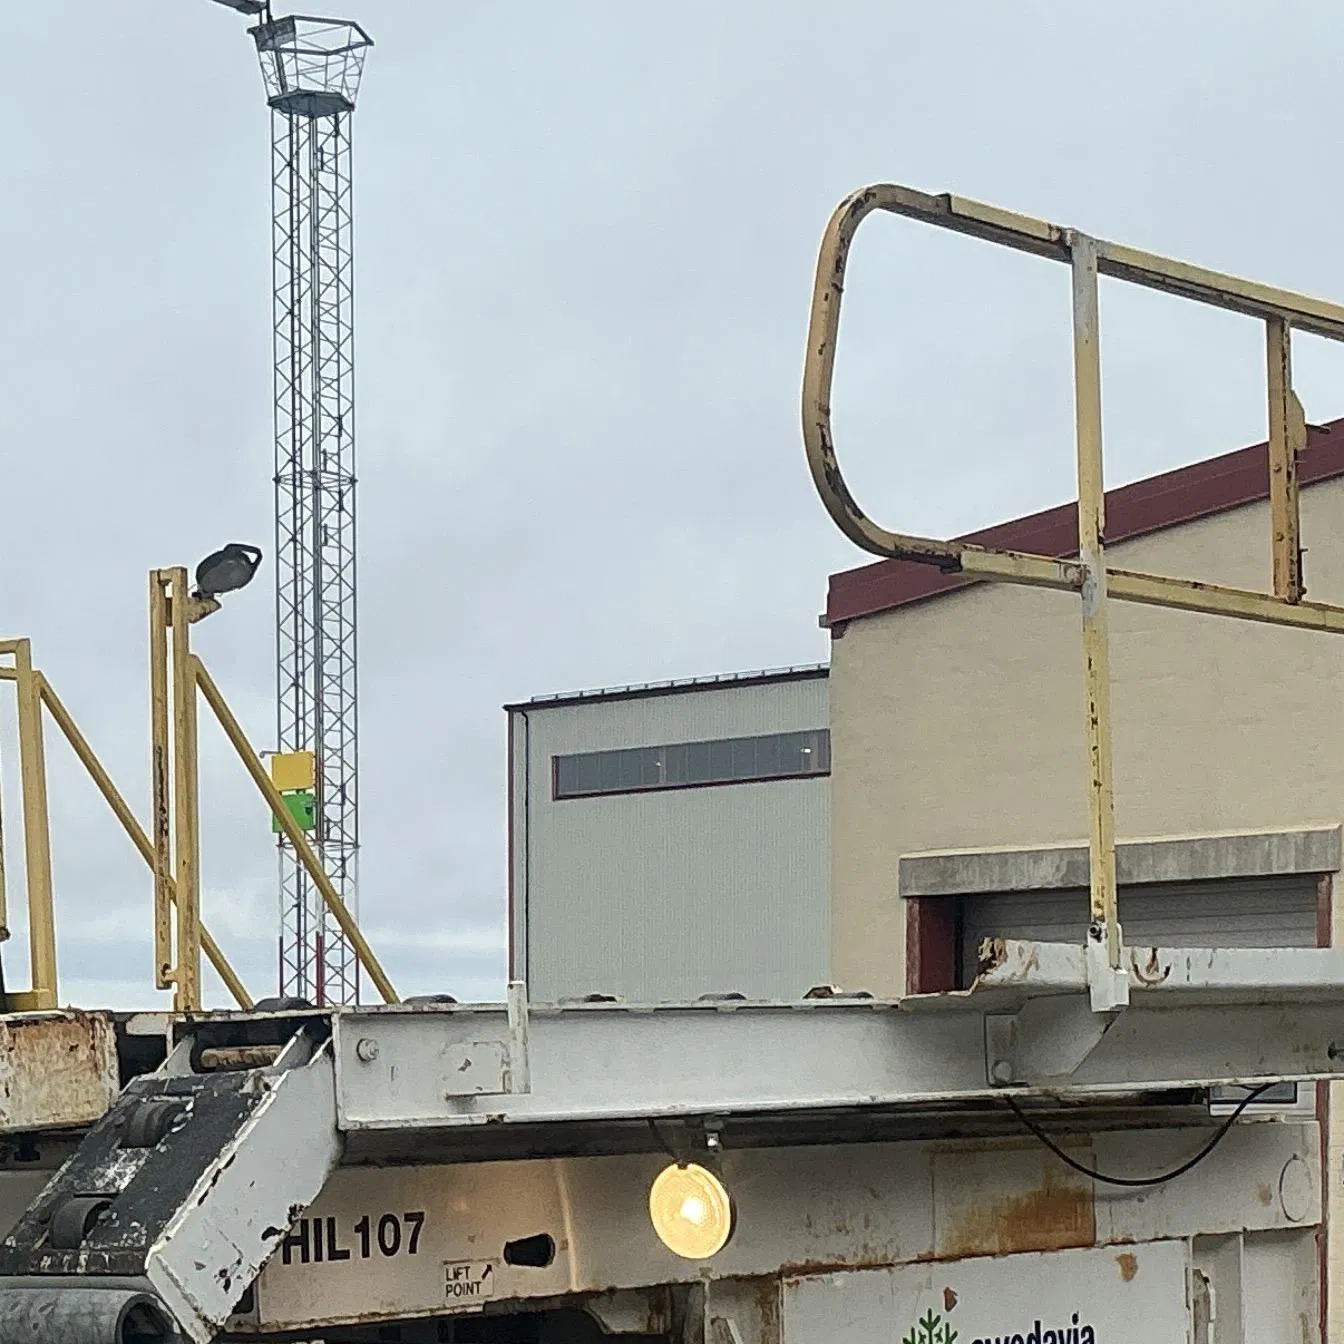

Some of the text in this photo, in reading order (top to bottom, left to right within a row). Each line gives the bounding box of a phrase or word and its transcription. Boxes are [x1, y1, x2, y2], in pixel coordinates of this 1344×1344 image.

[282, 1211, 425, 1266] HIL107
[445, 1265, 471, 1281] LIFT
[445, 1281, 482, 1298] POINT
